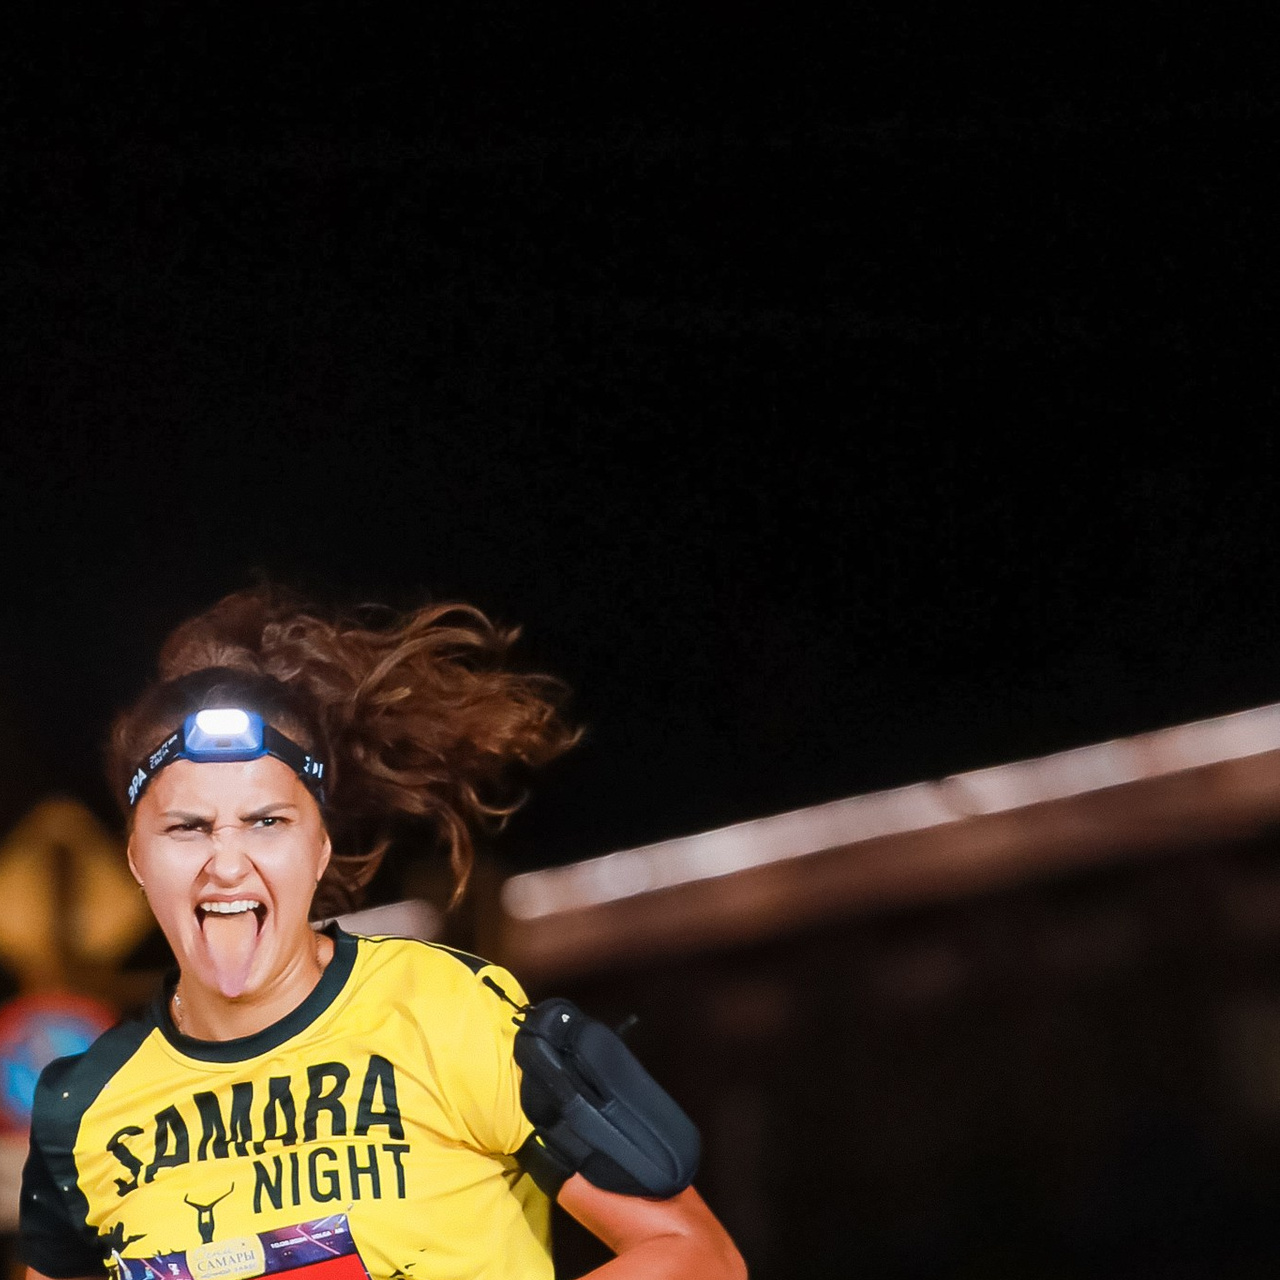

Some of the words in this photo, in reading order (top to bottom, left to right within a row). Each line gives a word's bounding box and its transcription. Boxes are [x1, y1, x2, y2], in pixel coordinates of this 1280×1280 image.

[106, 1054, 406, 1197] SAMARA
[252, 1143, 410, 1214] NIGHT
[197, 1249, 256, 1272] САМАРЫ
